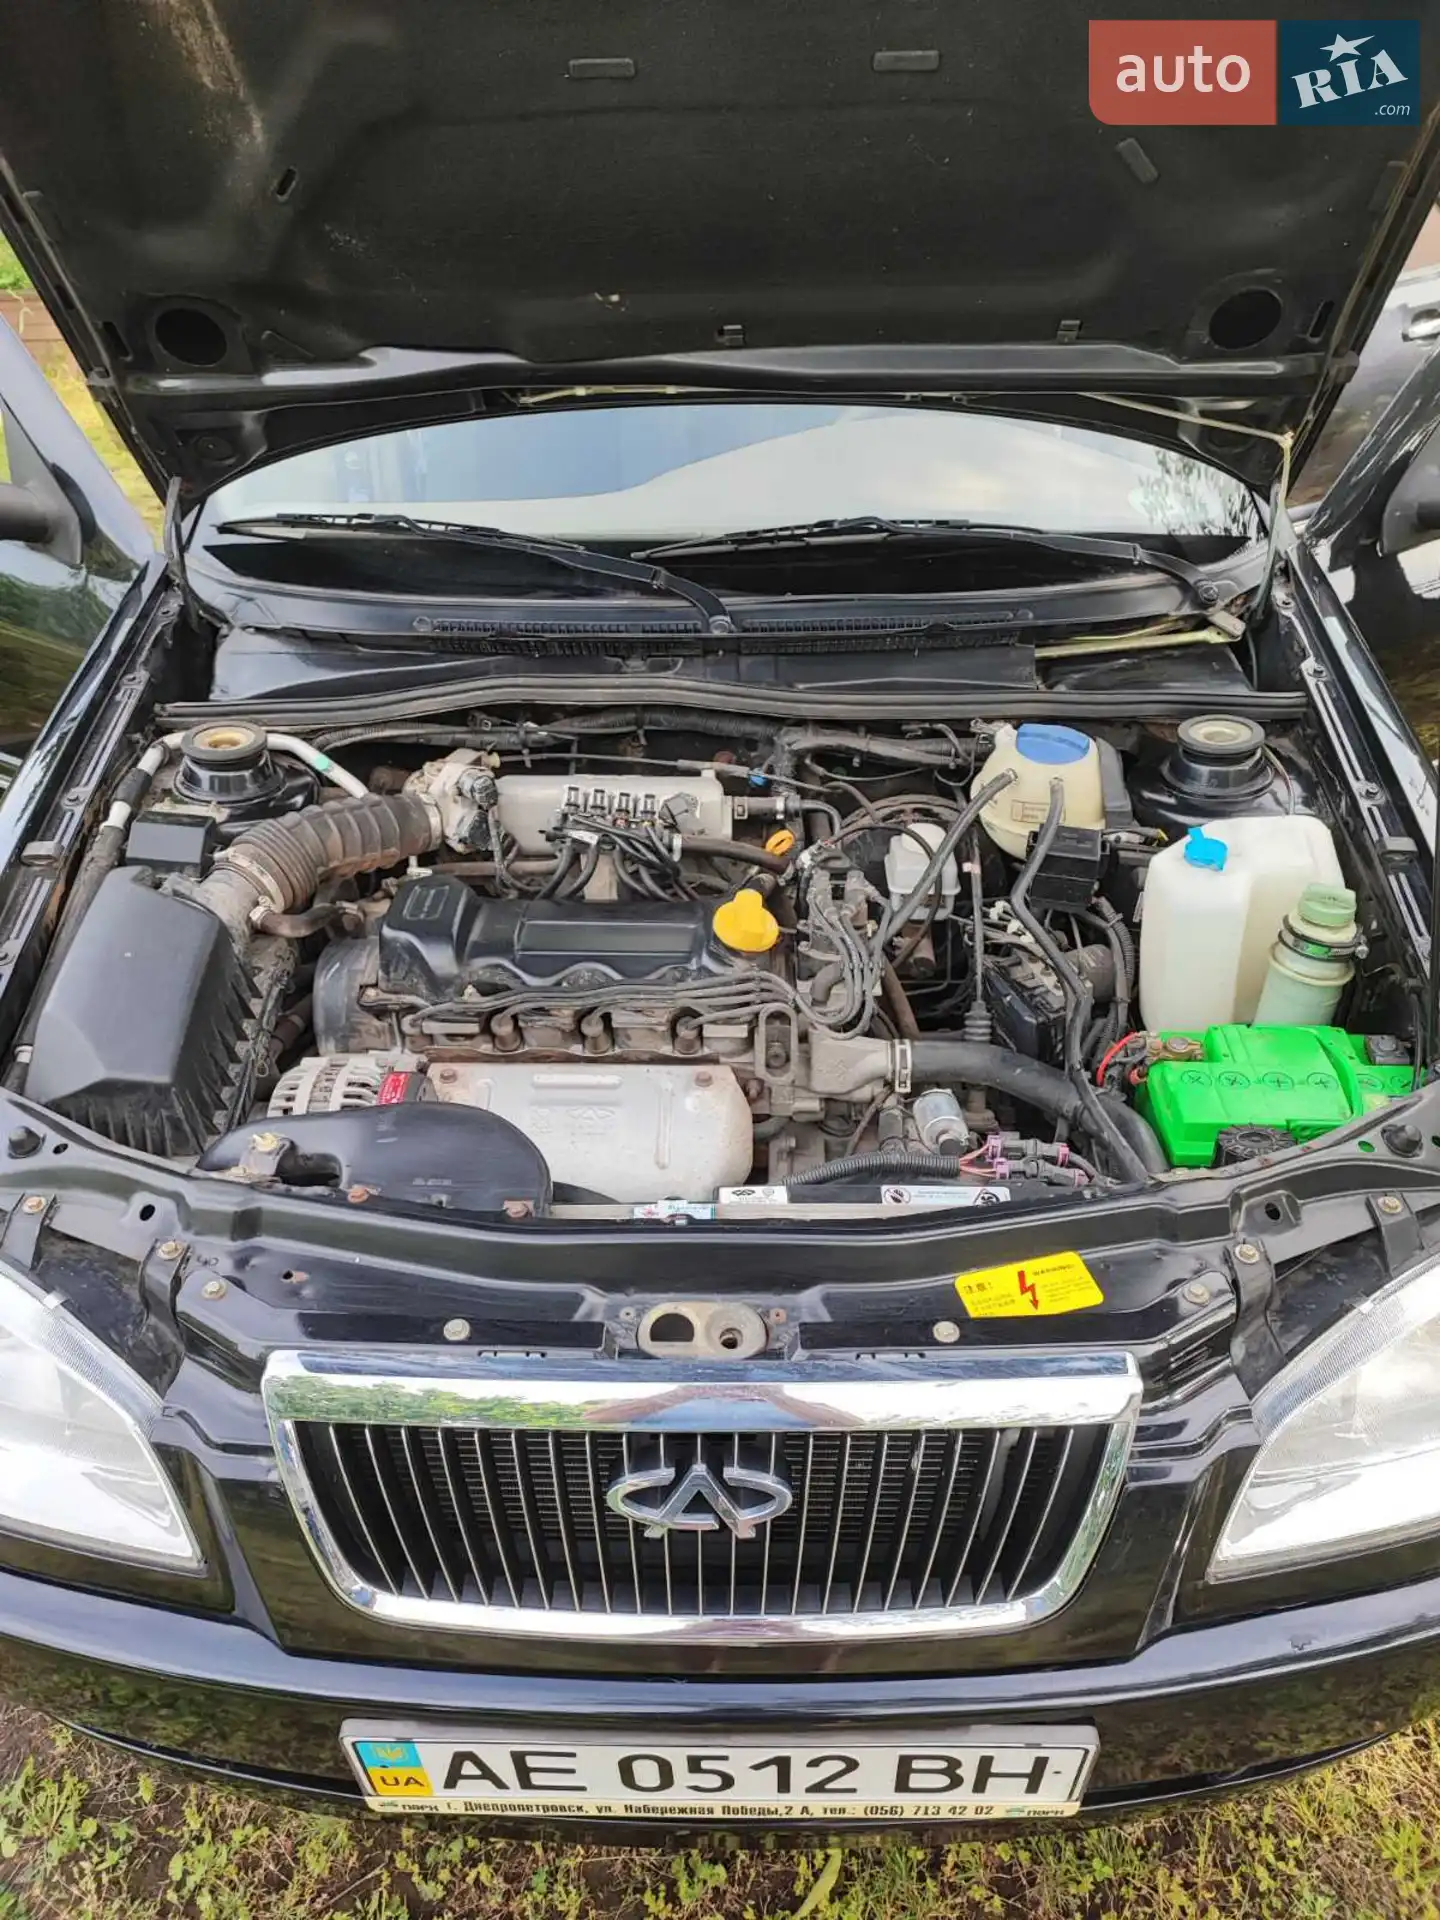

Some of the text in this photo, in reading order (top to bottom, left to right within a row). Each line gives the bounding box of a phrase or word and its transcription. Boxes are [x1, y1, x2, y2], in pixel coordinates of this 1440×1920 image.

[443, 1750, 1050, 1794] AE 0512 BH
[380, 1775, 425, 1787] UA
[464, 1801, 588, 1814] Днепропетровск,
[623, 1804, 714, 1815] Набережная
[863, 1804, 904, 1816] (056)
[911, 1804, 941, 1816] 713
[947, 1804, 967, 1816] 42
[974, 1804, 994, 1816] 02
